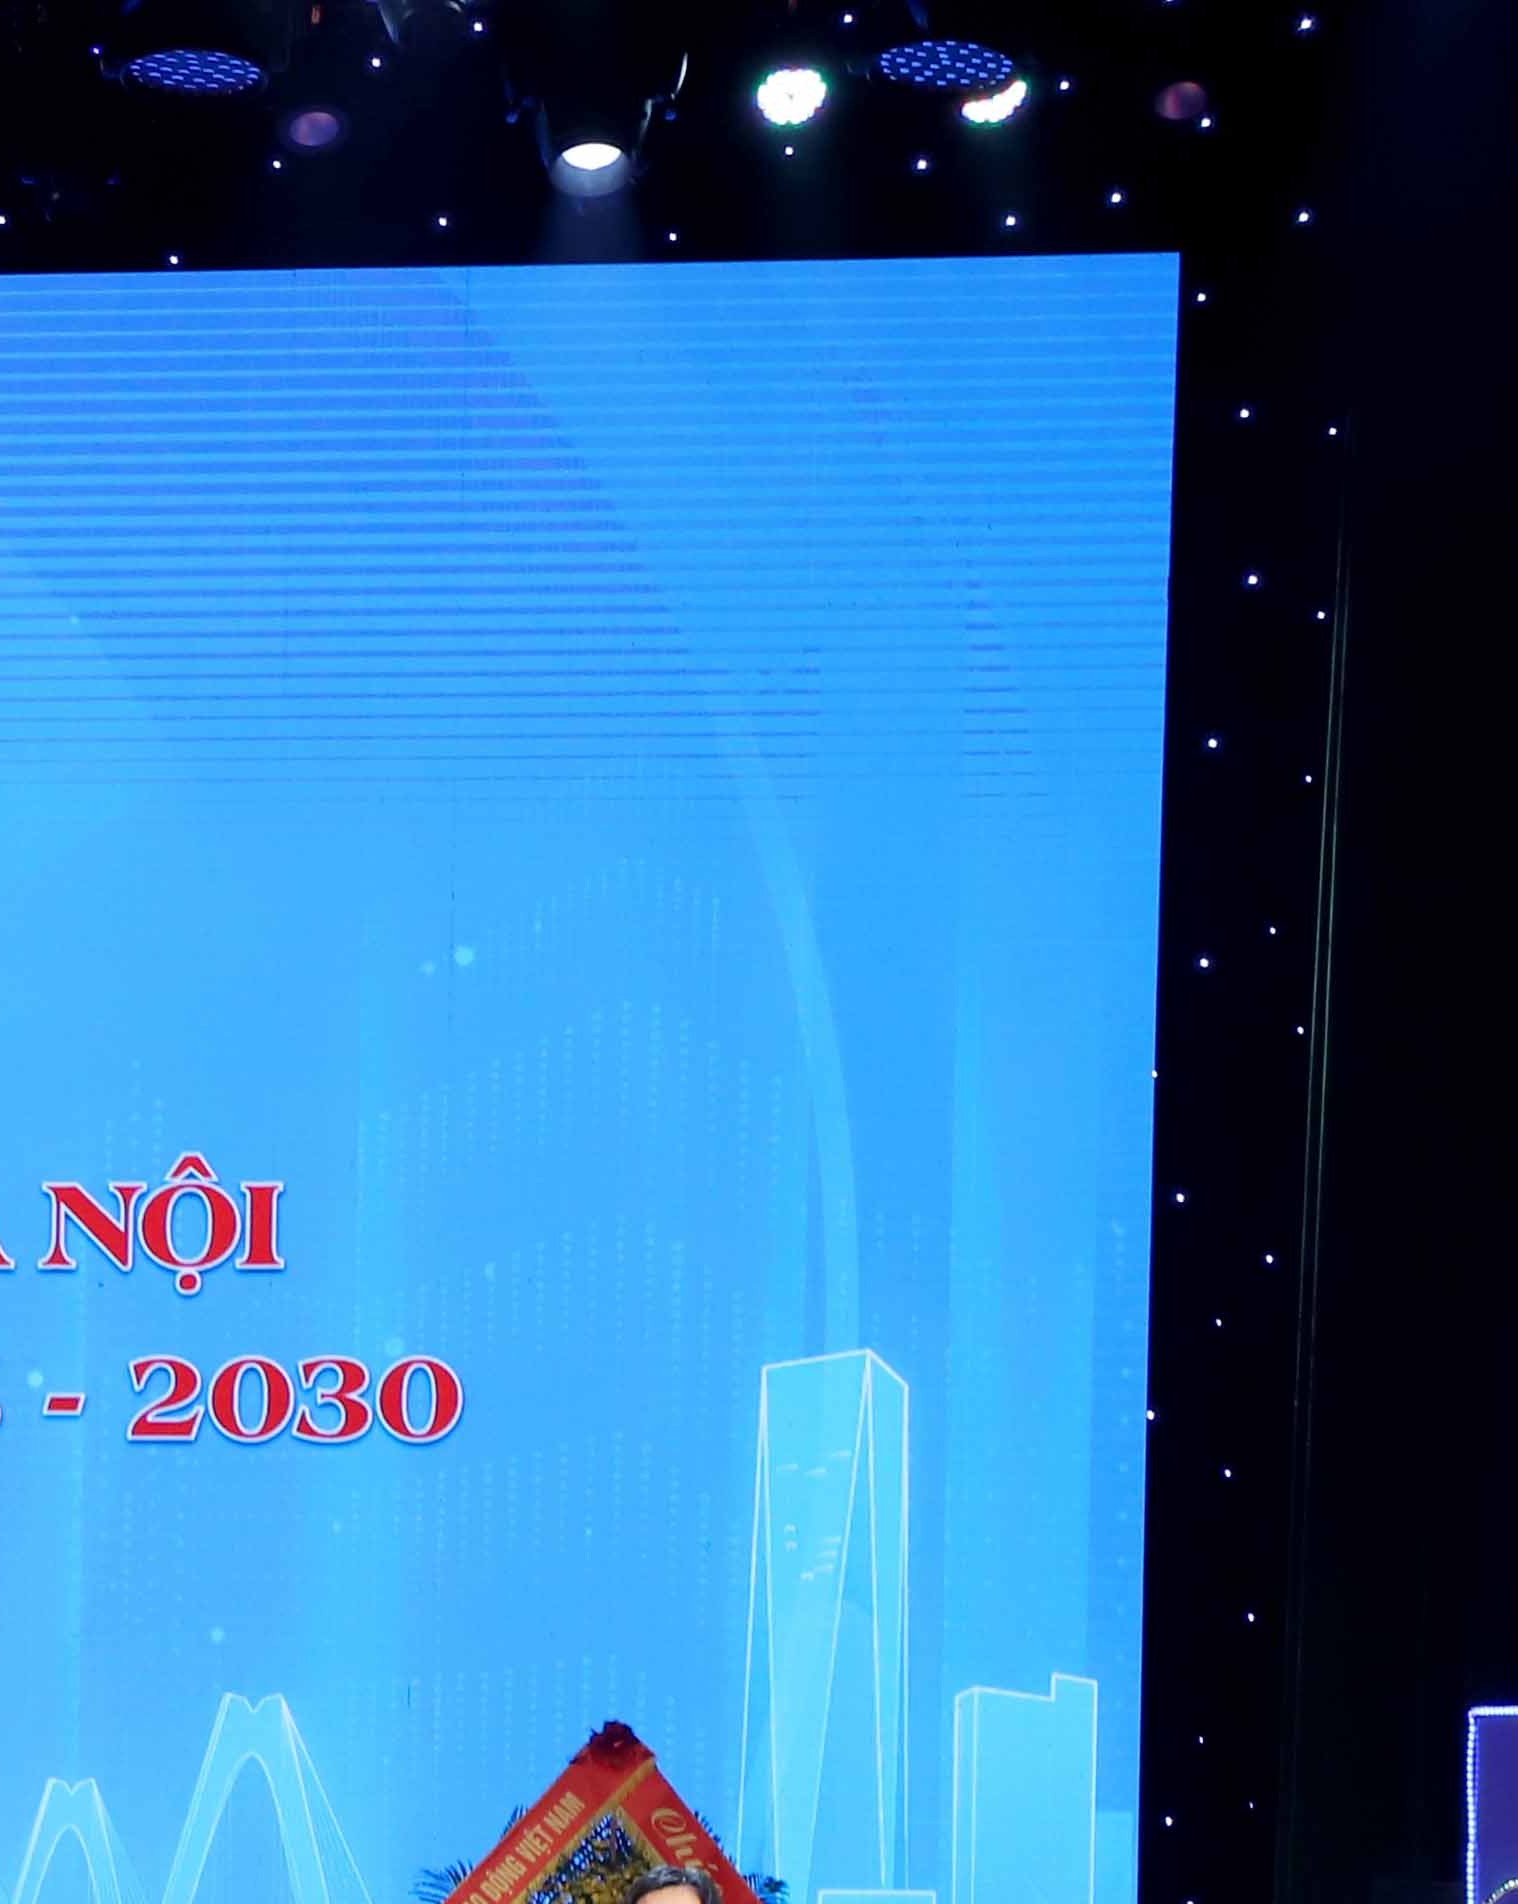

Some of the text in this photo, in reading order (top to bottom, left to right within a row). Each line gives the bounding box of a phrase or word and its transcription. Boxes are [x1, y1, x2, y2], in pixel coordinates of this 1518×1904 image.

[39, 1152, 285, 1295] NỘI
[41, 1392, 87, 1417] -
[127, 1355, 463, 1445] 2030
[480, 1854, 528, 1903] ĐỘNG
[515, 1823, 554, 1863] VIỆT
[543, 1791, 585, 1835] NAM
